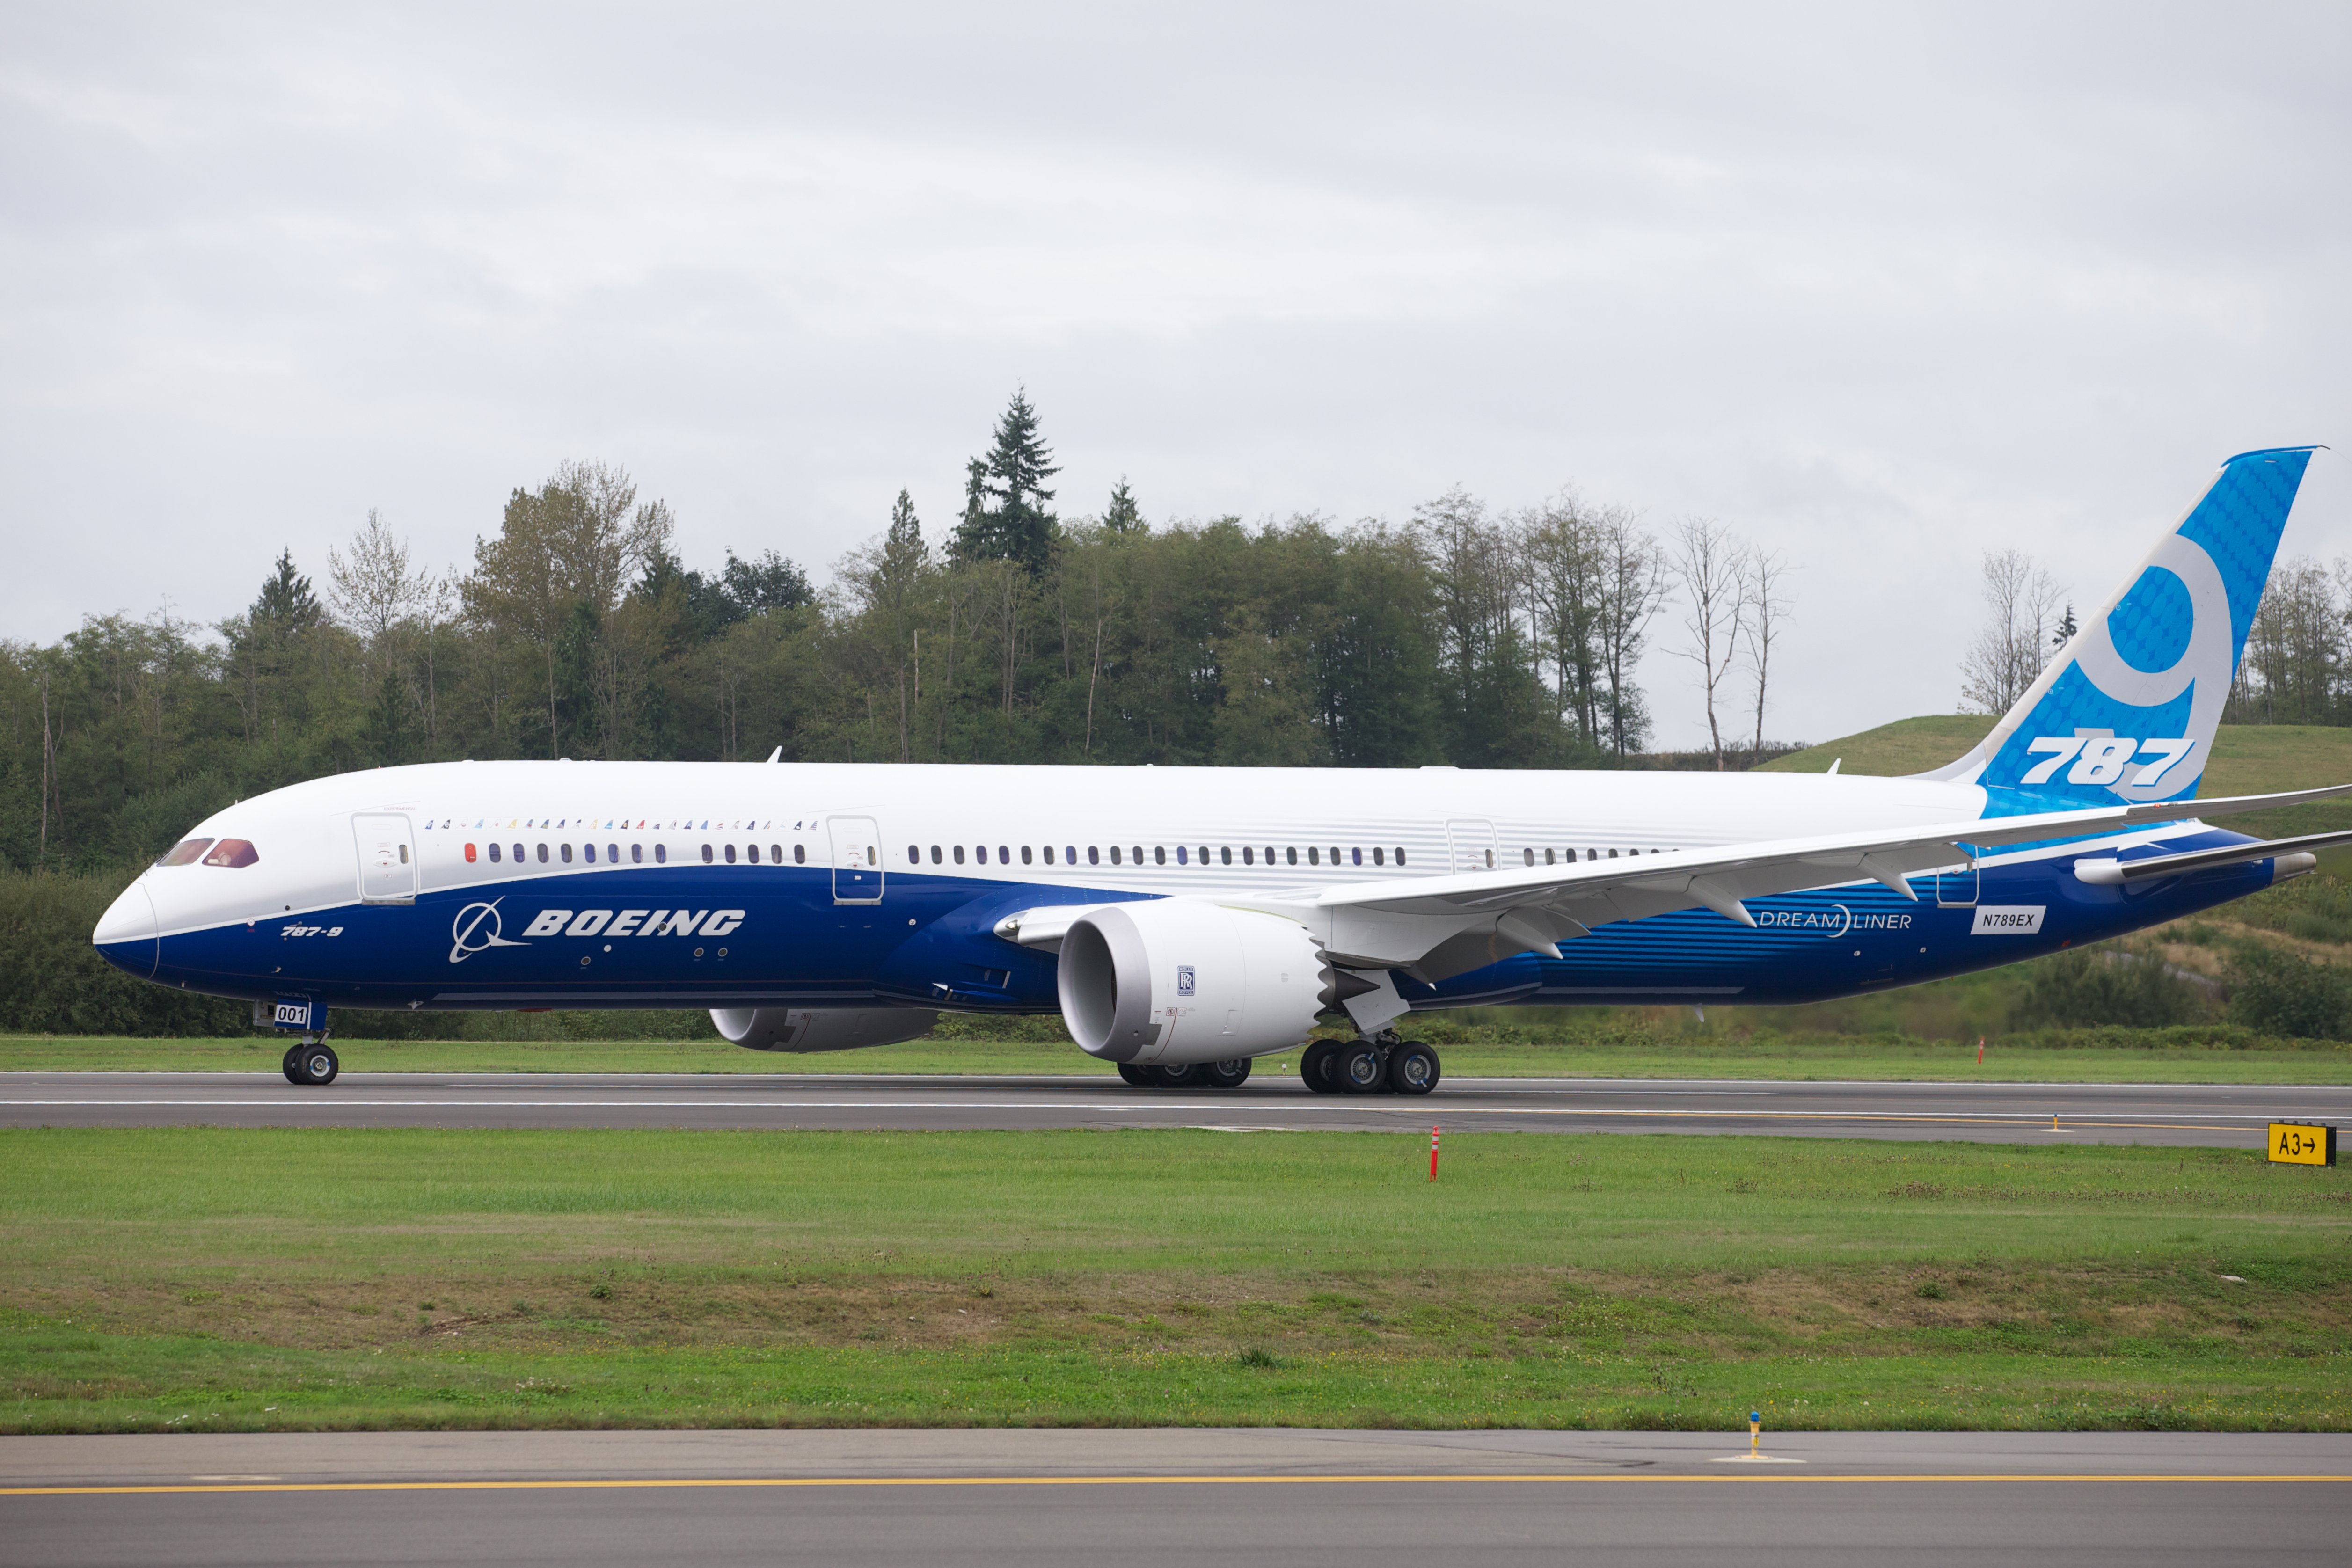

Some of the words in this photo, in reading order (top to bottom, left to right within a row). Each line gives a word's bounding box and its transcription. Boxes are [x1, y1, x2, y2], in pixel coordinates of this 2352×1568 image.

[2020, 737, 2195, 787] 787
[521, 910, 746, 936] BOEING
[1983, 914, 2035, 926] N789EX
[281, 926, 344, 936] 787-9
[278, 1007, 304, 1021] 001
[2279, 1132, 2300, 1155] A3
